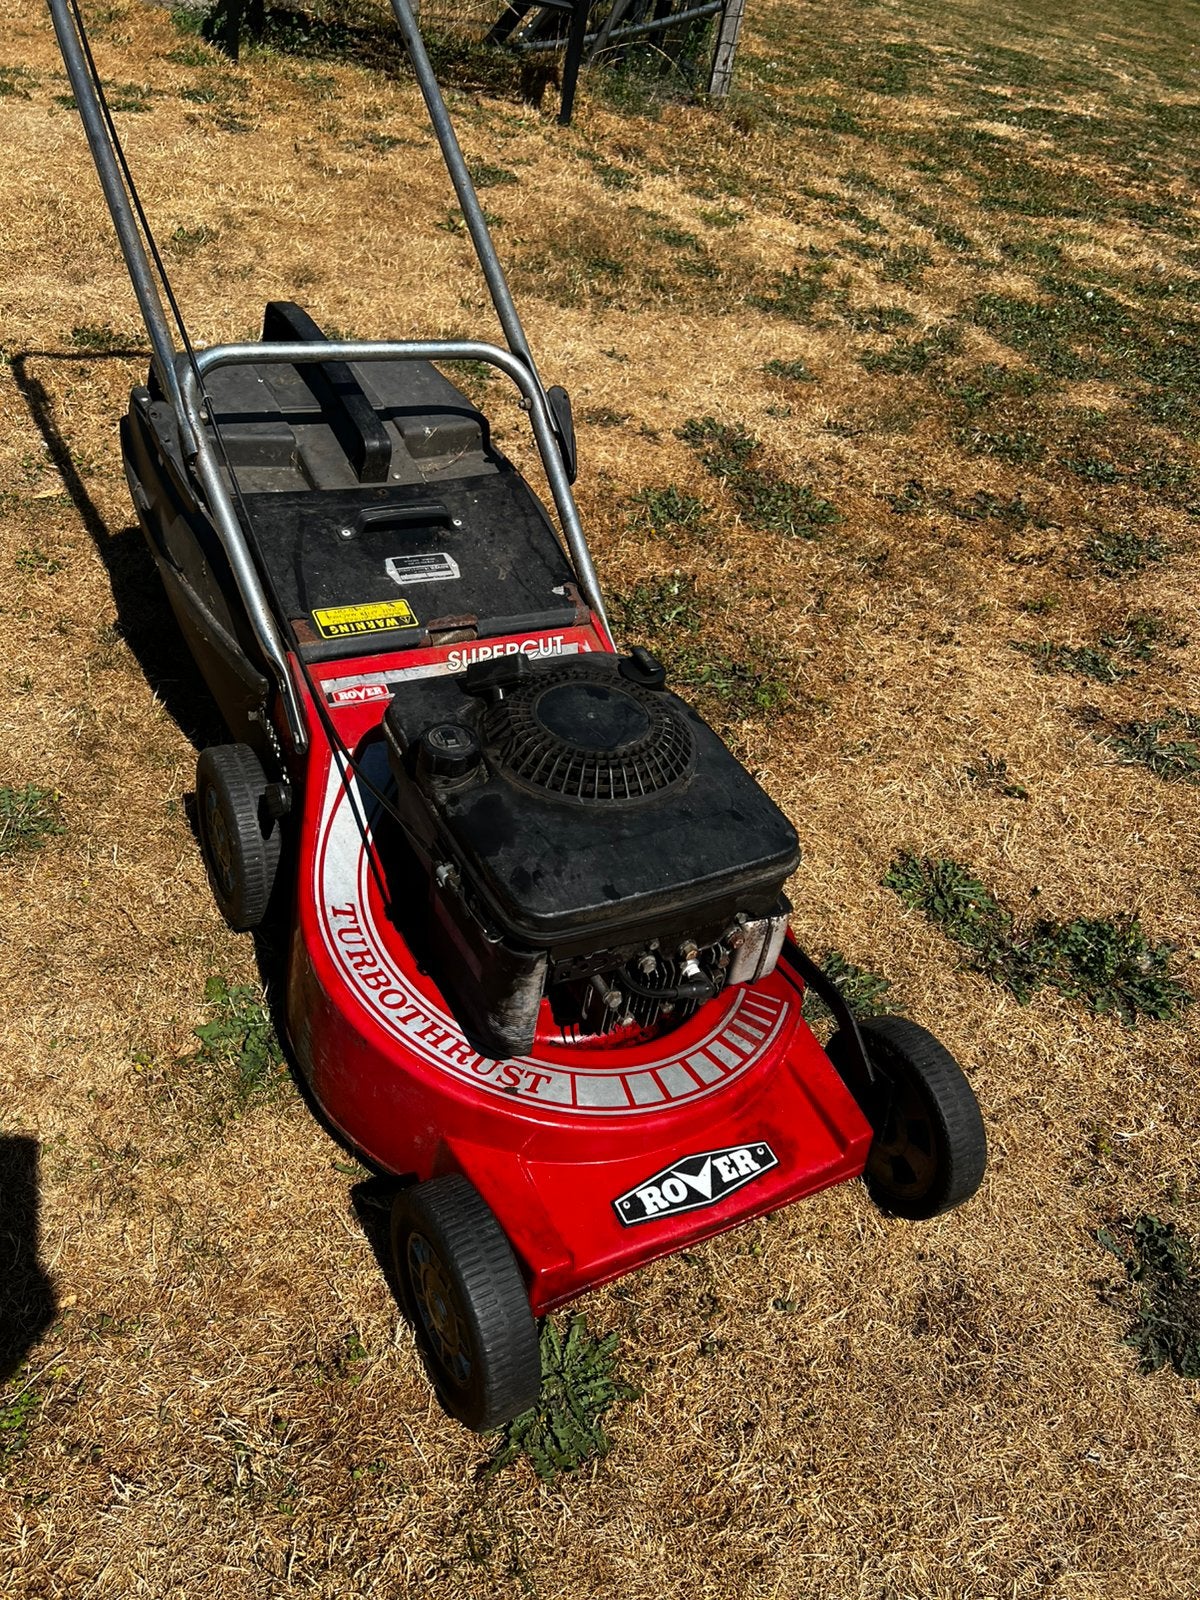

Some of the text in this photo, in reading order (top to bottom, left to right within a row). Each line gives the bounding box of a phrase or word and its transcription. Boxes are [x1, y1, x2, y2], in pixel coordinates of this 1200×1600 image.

[329, 617, 399, 635] WARNING
[338, 686, 384, 700] ROVER
[331, 902, 552, 1094] TURBOTHRUST
[636, 1148, 761, 1216] ROVER
